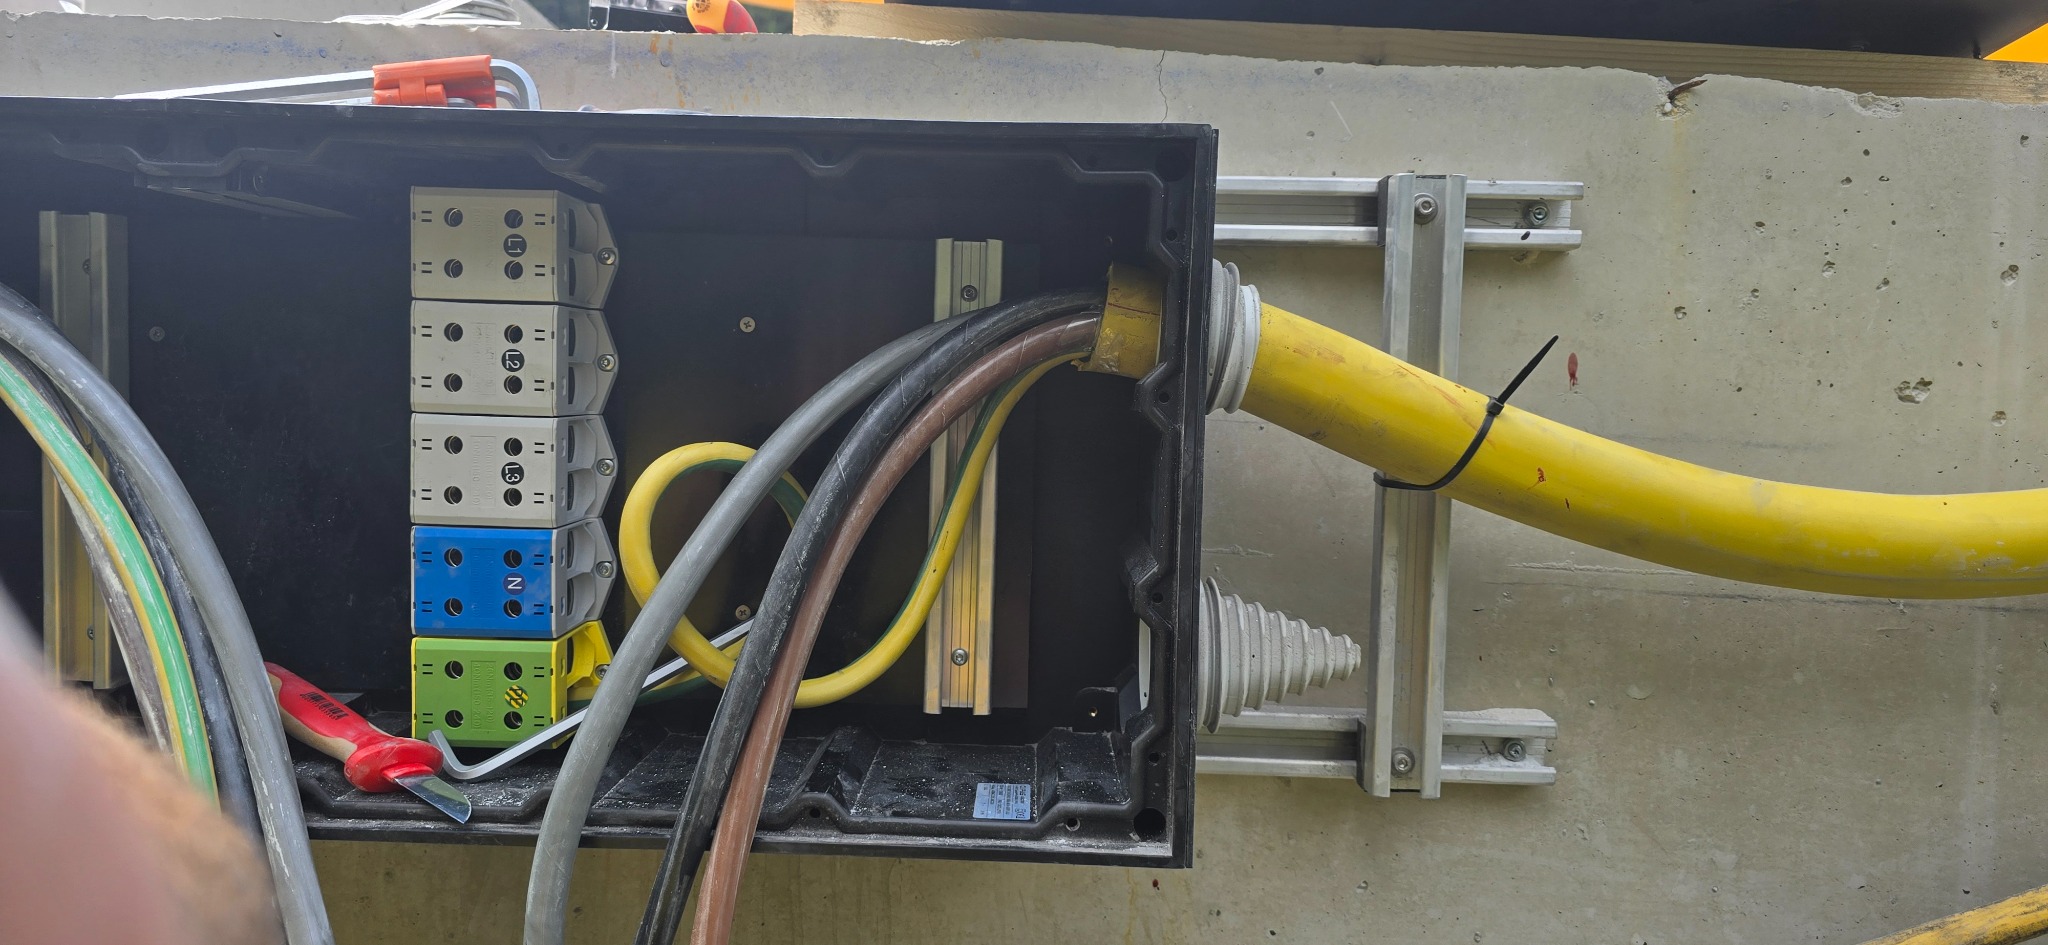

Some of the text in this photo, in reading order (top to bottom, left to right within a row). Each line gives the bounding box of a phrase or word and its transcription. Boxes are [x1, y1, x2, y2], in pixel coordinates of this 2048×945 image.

[508, 238, 523, 253] L1
[505, 351, 520, 369] L2
[505, 465, 520, 482] L3
[507, 577, 523, 590] N
[509, 688, 524, 704] PE
